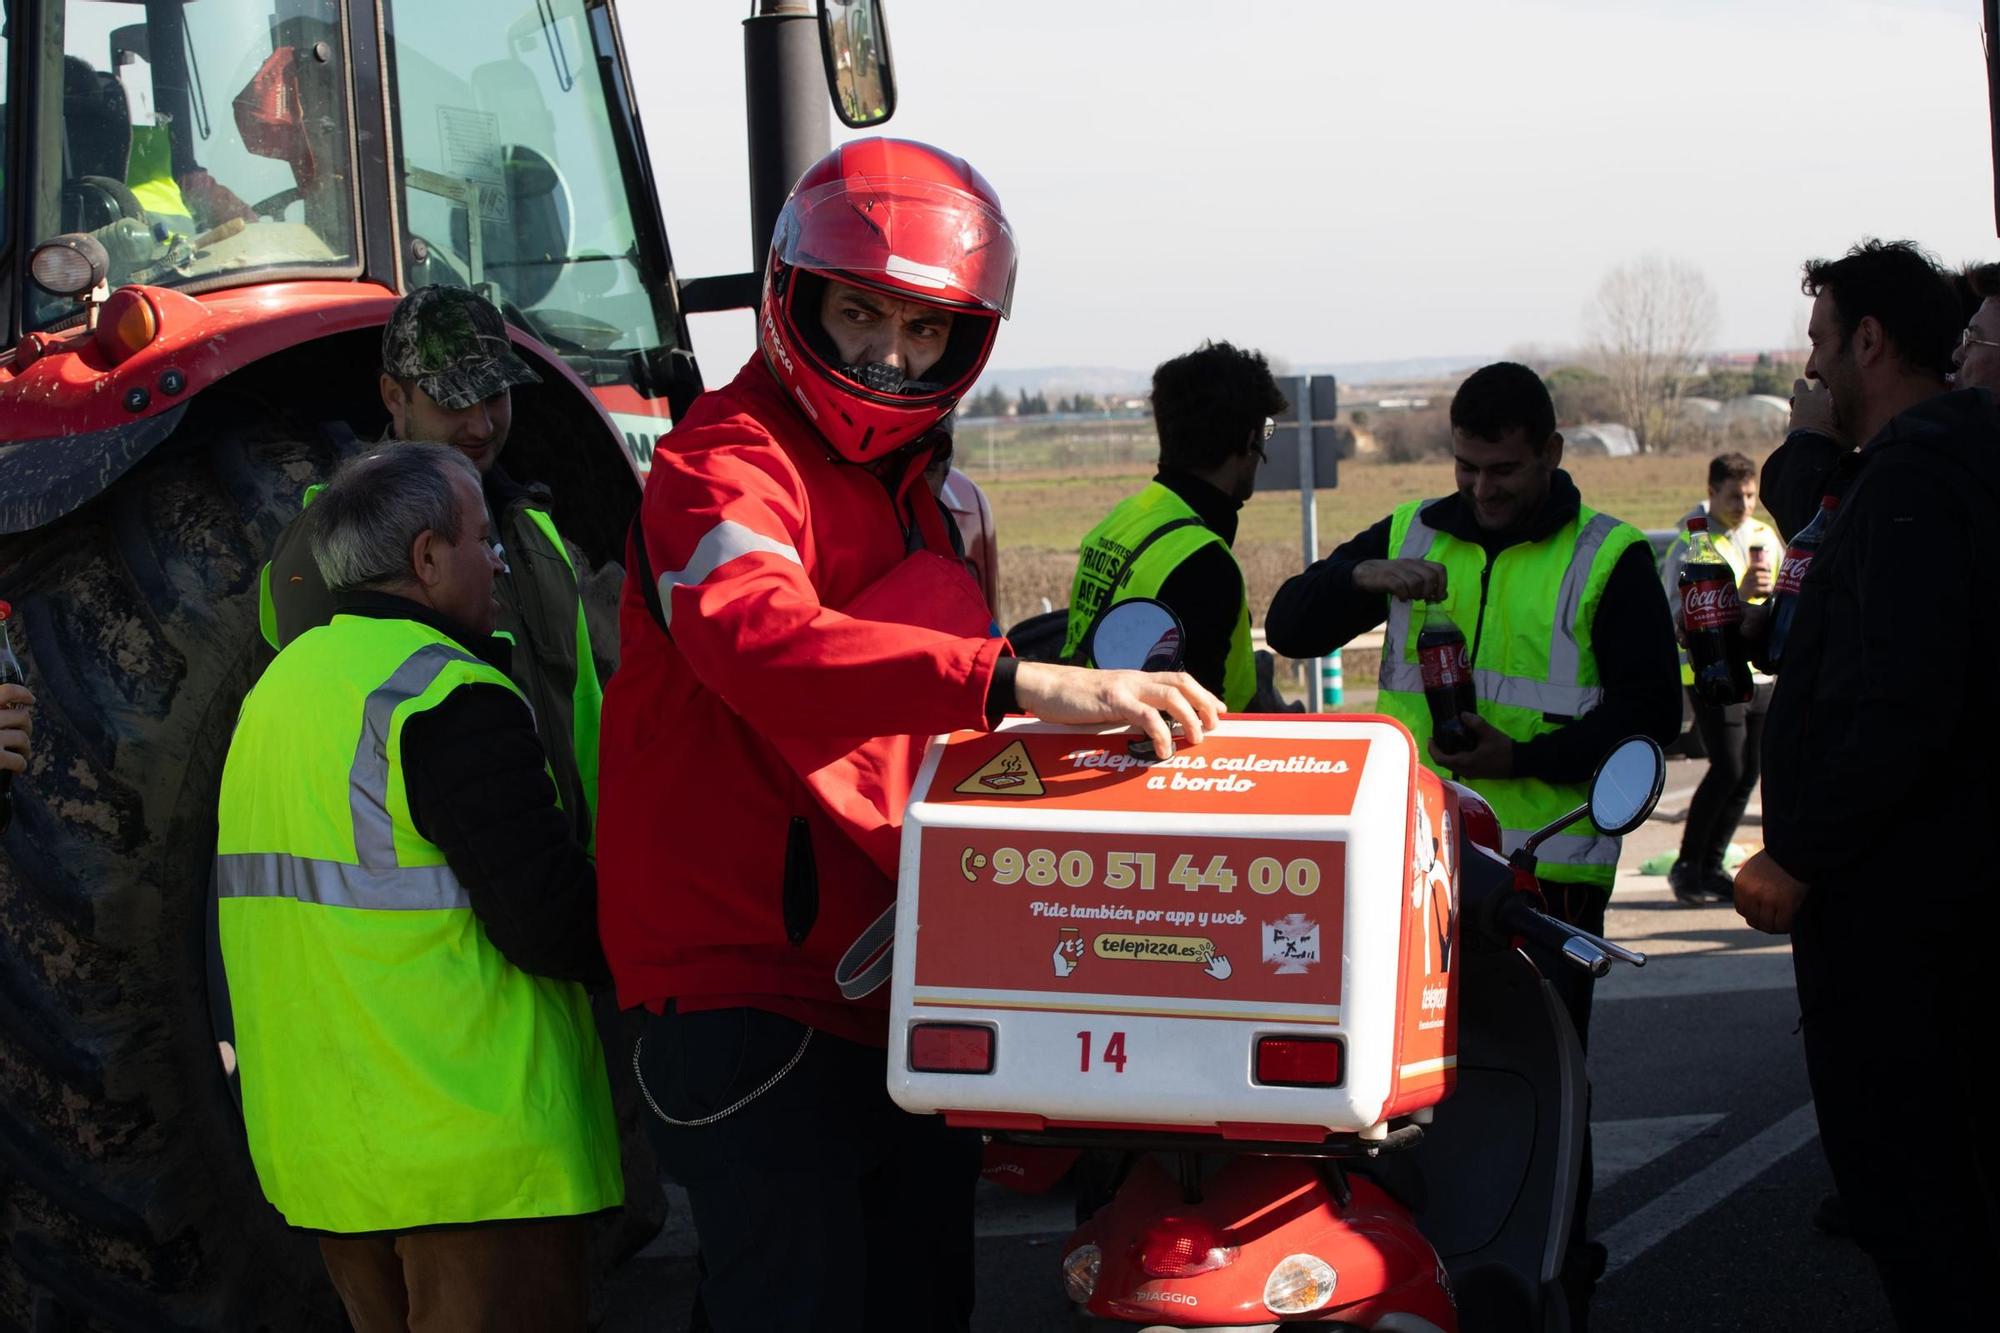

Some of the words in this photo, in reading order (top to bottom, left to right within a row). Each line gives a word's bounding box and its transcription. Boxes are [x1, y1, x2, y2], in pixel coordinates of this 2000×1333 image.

[1211, 754, 1350, 774] calentitas
[1146, 774, 1168, 790] a
[1170, 772, 1256, 793] bordo
[992, 847, 1094, 889] 980
[1103, 850, 1157, 890] 51
[1167, 853, 1238, 894] 44
[1247, 856, 1321, 897] 00
[1029, 901, 1069, 918] Pide
[1070, 902, 1135, 922] también
[1135, 908, 1164, 923] por
[1165, 911, 1197, 926] app
[1197, 913, 1210, 928] y
[1211, 910, 1247, 925] web
[1100, 936, 1197, 959] telepizza.es
[1076, 1030, 1127, 1073] 14
[1136, 1291, 1198, 1306] PIAGGIO
